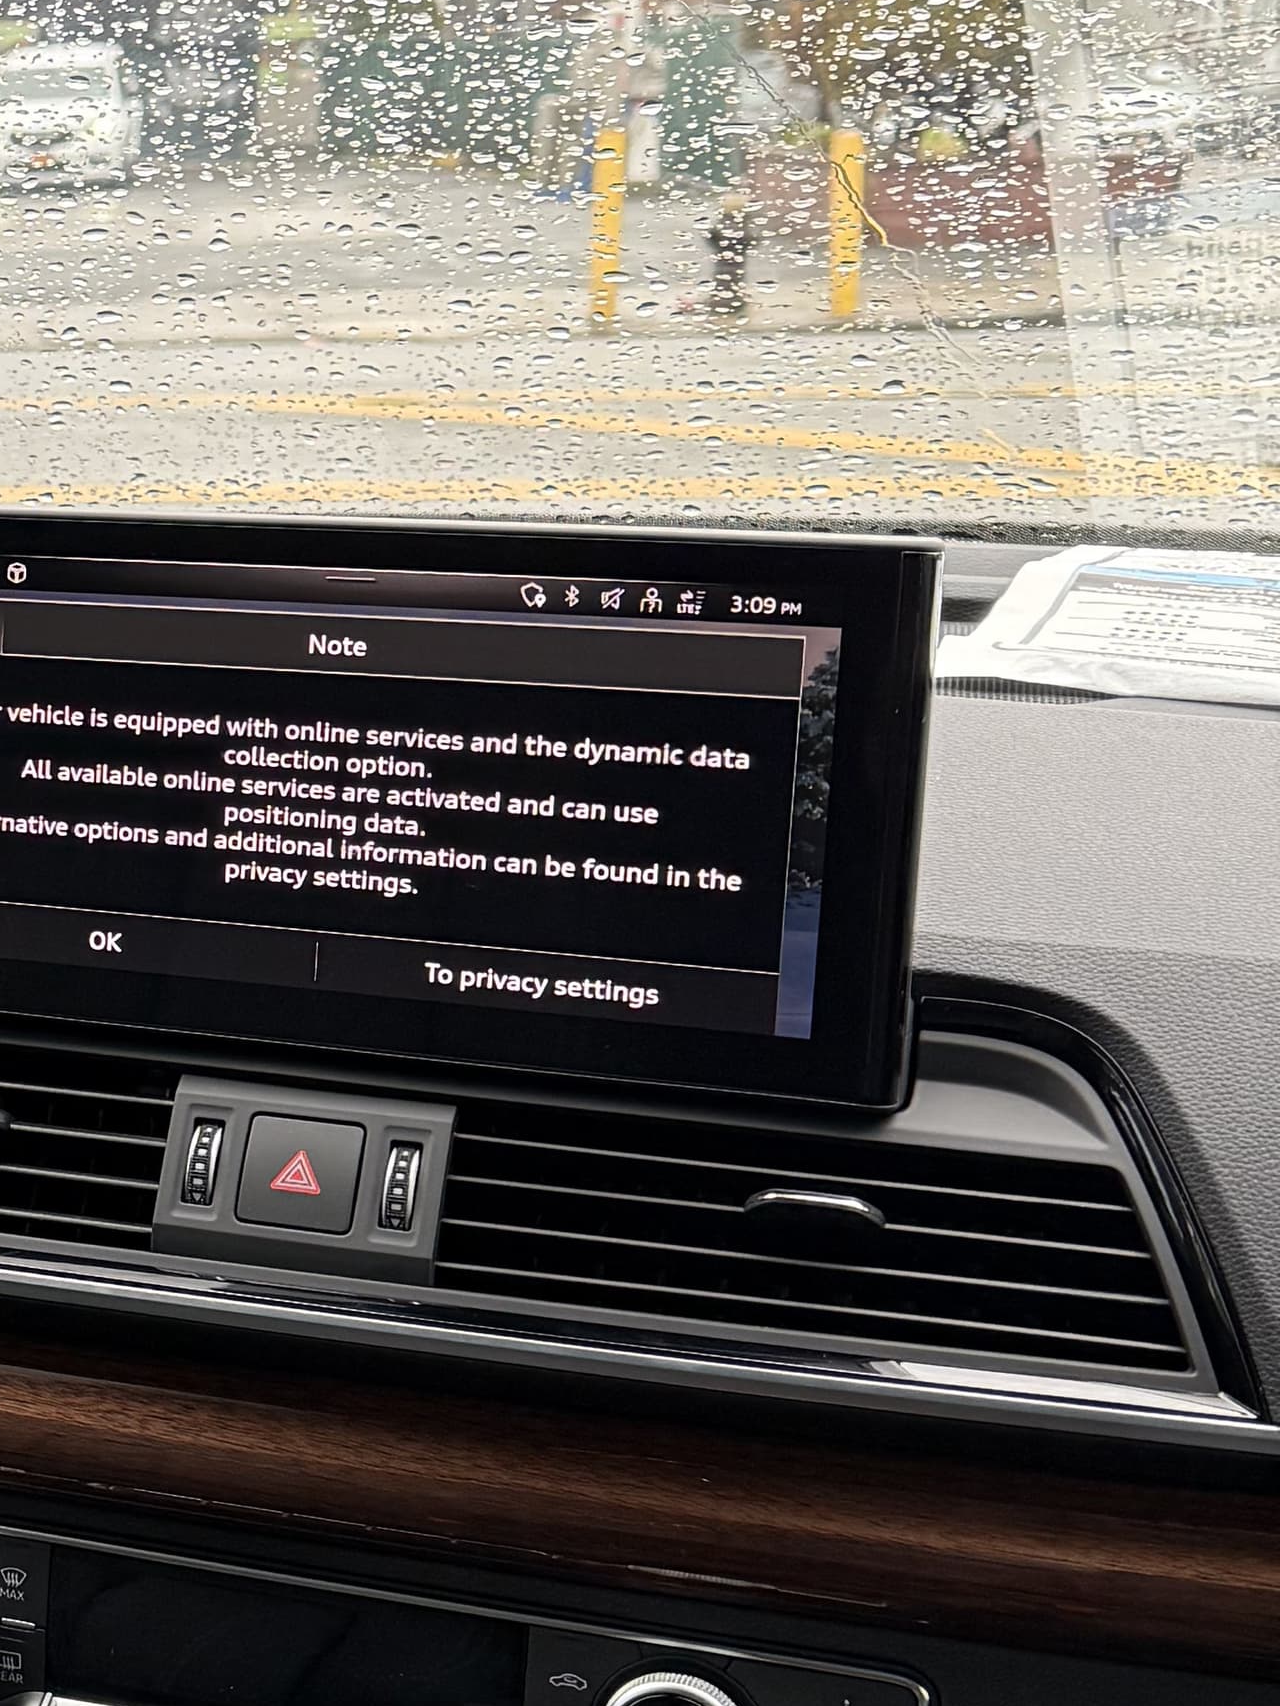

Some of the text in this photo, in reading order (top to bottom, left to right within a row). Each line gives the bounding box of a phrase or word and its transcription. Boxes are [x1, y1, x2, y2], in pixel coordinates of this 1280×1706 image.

[730, 595, 802, 616] 3:09 PM
[308, 633, 368, 657] Note
[6, 702, 85, 727] vehicle
[90, 707, 109, 728] is
[113, 711, 221, 738] equipped
[225, 717, 279, 742] with
[284, 720, 360, 746] online
[365, 729, 465, 752] services
[470, 732, 518, 755] and
[524, 734, 568, 758] the
[573, 737, 684, 766] dynamic
[689, 744, 750, 770] data
[223, 745, 433, 780] collection option.
[20, 758, 659, 825] All available online services are activated and can use
[224, 805, 426, 838] positioning data.
[73, 821, 160, 844] options
[164, 827, 208, 848] and
[213, 832, 335, 859] additional
[340, 841, 487, 871] information
[493, 856, 538, 875] can
[544, 854, 576, 878] be
[581, 857, 659, 885] found
[666, 864, 691, 887] in
[696, 867, 743, 891] the
[224, 860, 418, 898] privacy settings.
[88, 930, 123, 953] OK
[424, 961, 660, 1009] To privacy settings
[0, 1587, 25, 1602] MAX
